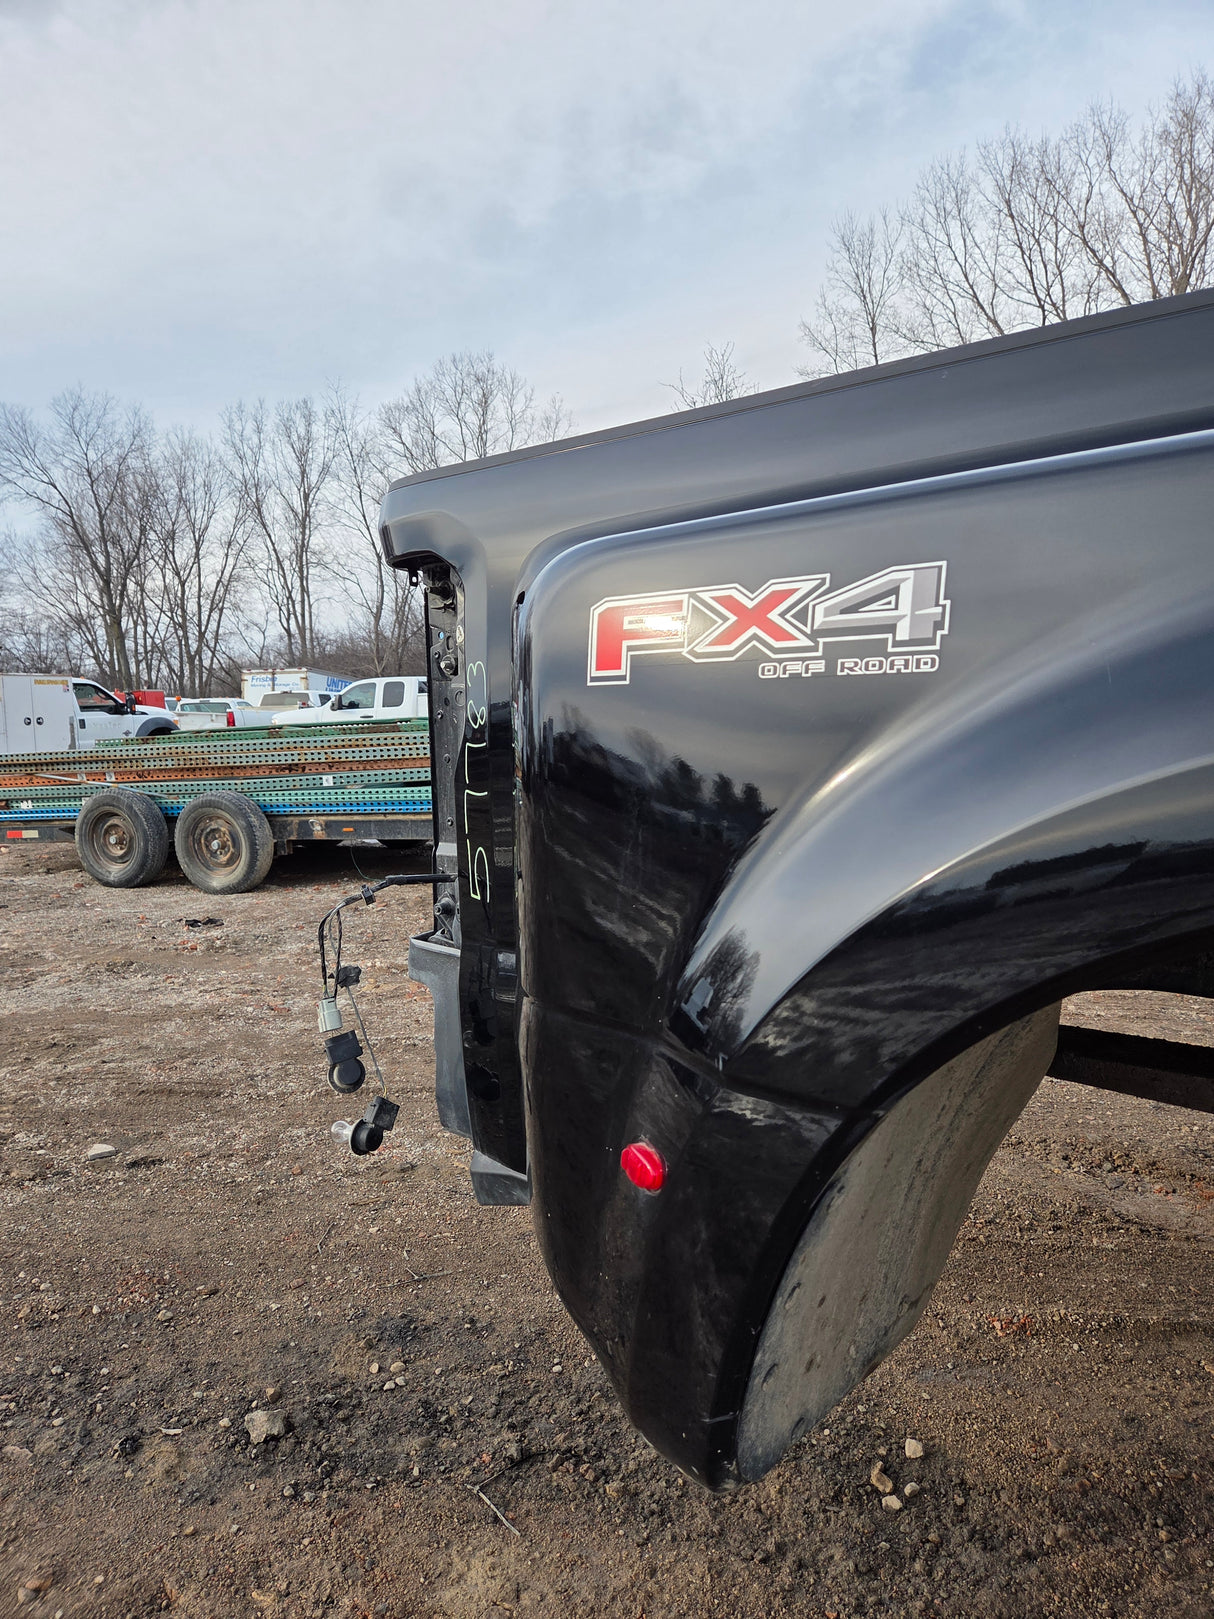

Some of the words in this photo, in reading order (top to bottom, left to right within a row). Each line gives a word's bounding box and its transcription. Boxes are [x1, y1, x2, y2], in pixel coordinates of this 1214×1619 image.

[587, 561, 950, 686] FX4
[758, 660, 826, 679] OFF
[836, 654, 940, 676] ROAD
[464, 660, 489, 903] 57783
